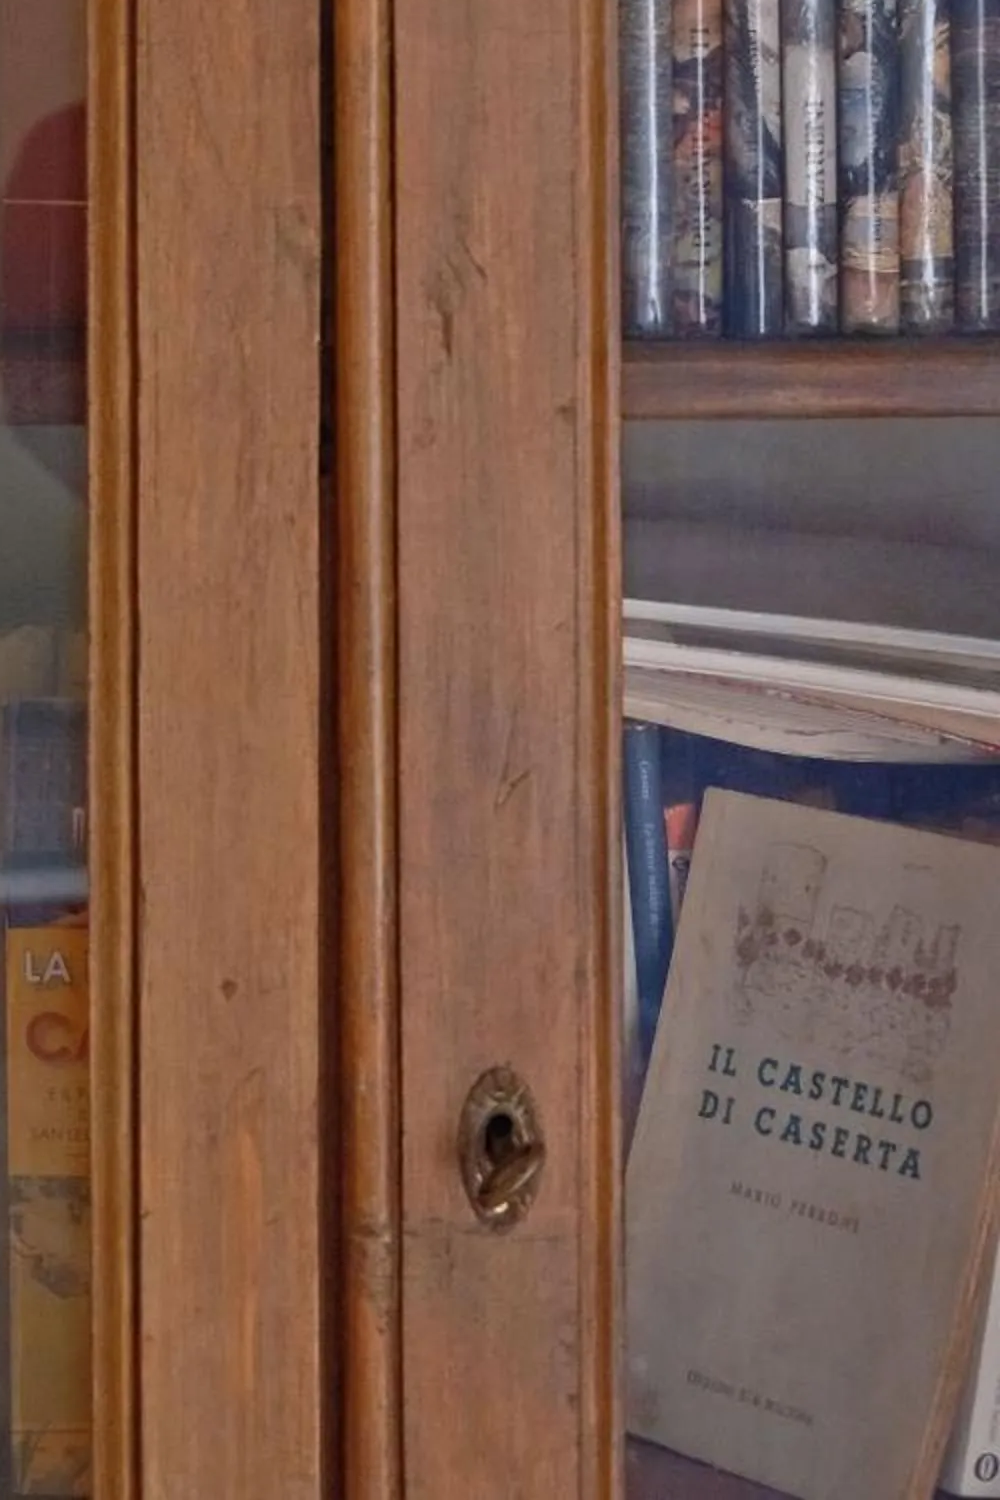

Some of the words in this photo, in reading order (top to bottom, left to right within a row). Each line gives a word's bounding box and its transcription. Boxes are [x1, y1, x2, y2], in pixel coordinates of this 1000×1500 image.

[23, 950, 72, 983] LA
[707, 1043, 737, 1077] IL
[756, 1056, 935, 1131] CASTELLO
[697, 1088, 736, 1125] DI
[753, 1105, 922, 1180] CASERTA
[729, 1180, 782, 1208] MARIO
